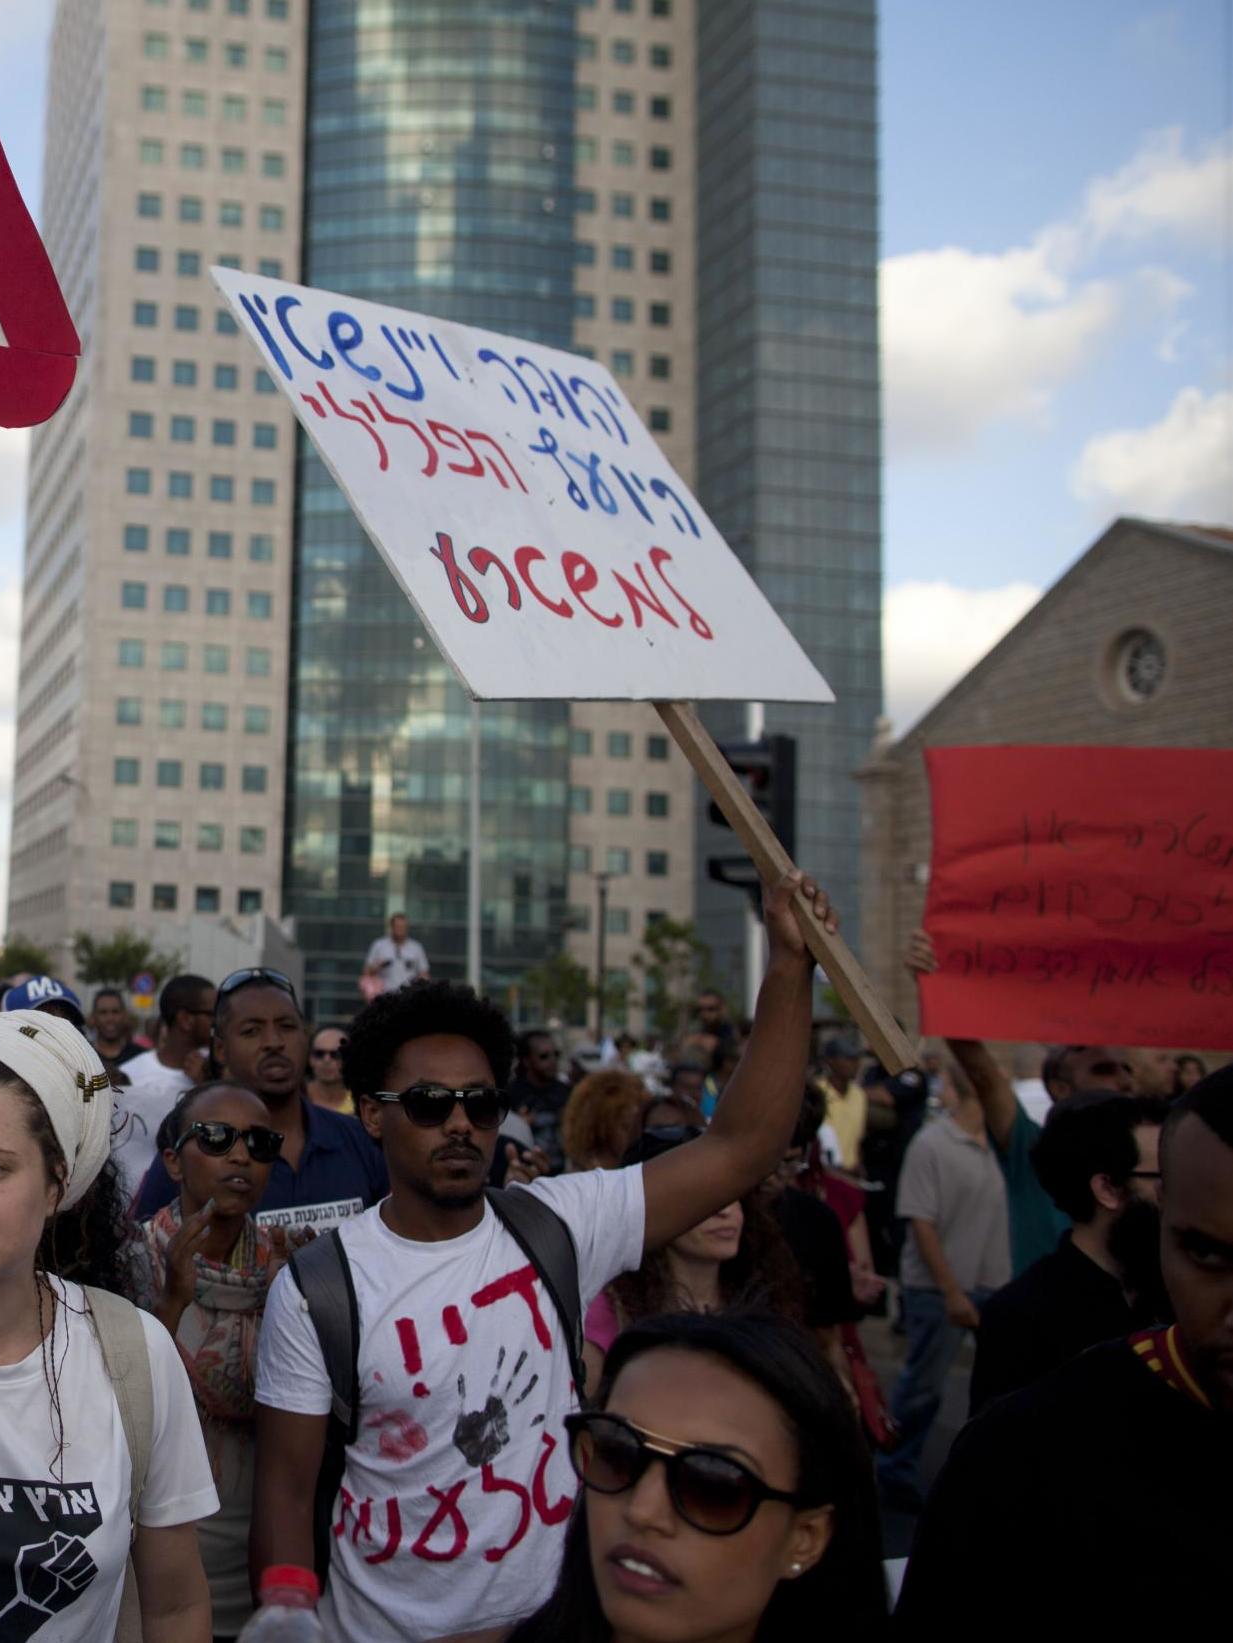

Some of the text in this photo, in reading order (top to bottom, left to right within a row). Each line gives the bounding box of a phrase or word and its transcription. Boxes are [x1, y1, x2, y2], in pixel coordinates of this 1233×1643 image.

[301, 381, 529, 494] הפלילי
[478, 349, 630, 445] יהודה
[22, 1486, 97, 1522] ארץ
